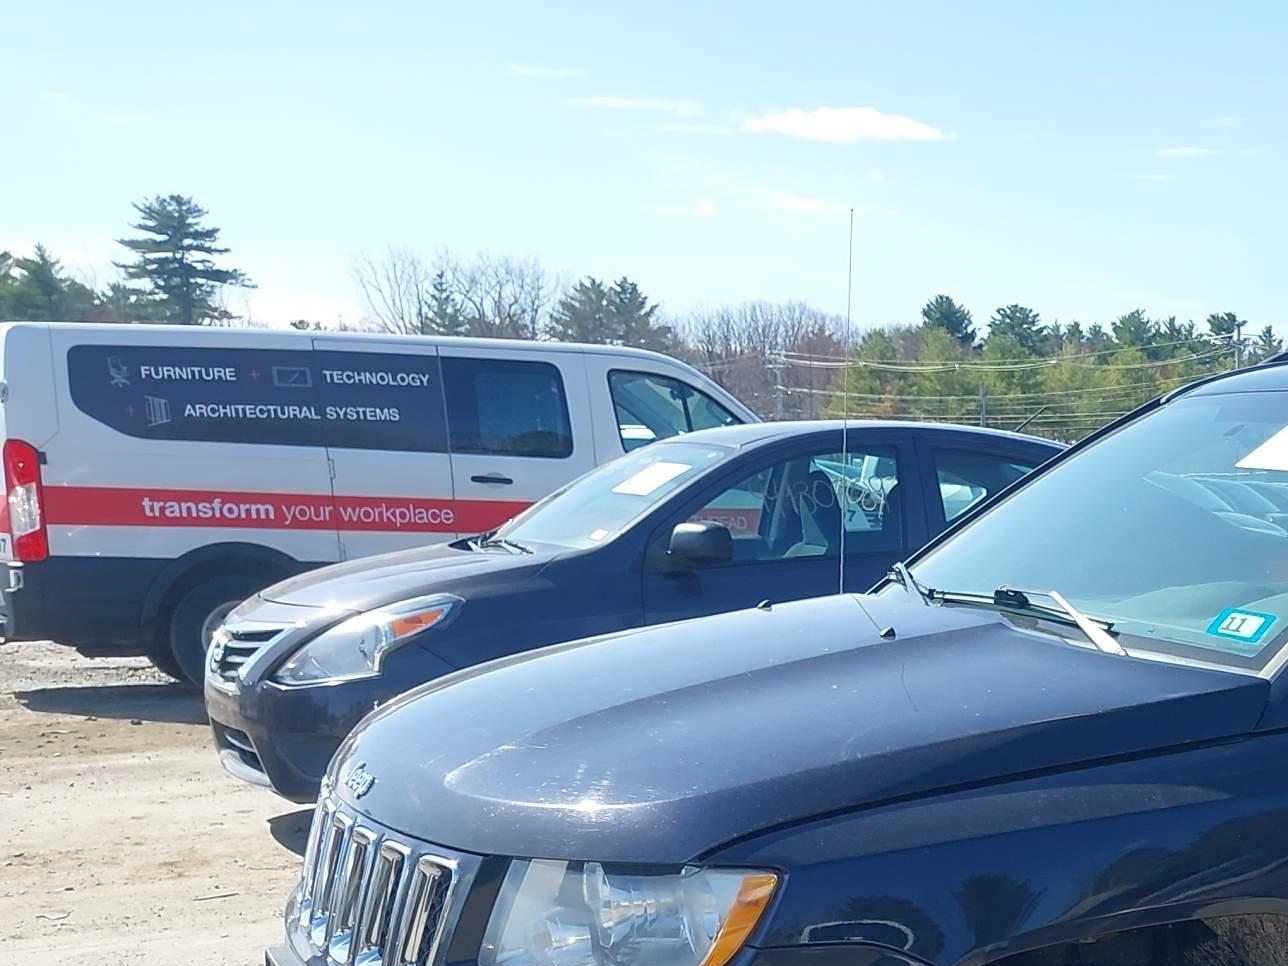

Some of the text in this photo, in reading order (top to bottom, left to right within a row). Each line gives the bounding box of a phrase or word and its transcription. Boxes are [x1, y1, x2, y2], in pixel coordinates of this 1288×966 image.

[140, 365, 430, 388] FURNITURE TECHNOLOGY
[184, 403, 400, 422] ARCHITECTURAL SYSTEMS
[142, 497, 454, 527] transform your workplace
[345, 760, 375, 799] Jeep
